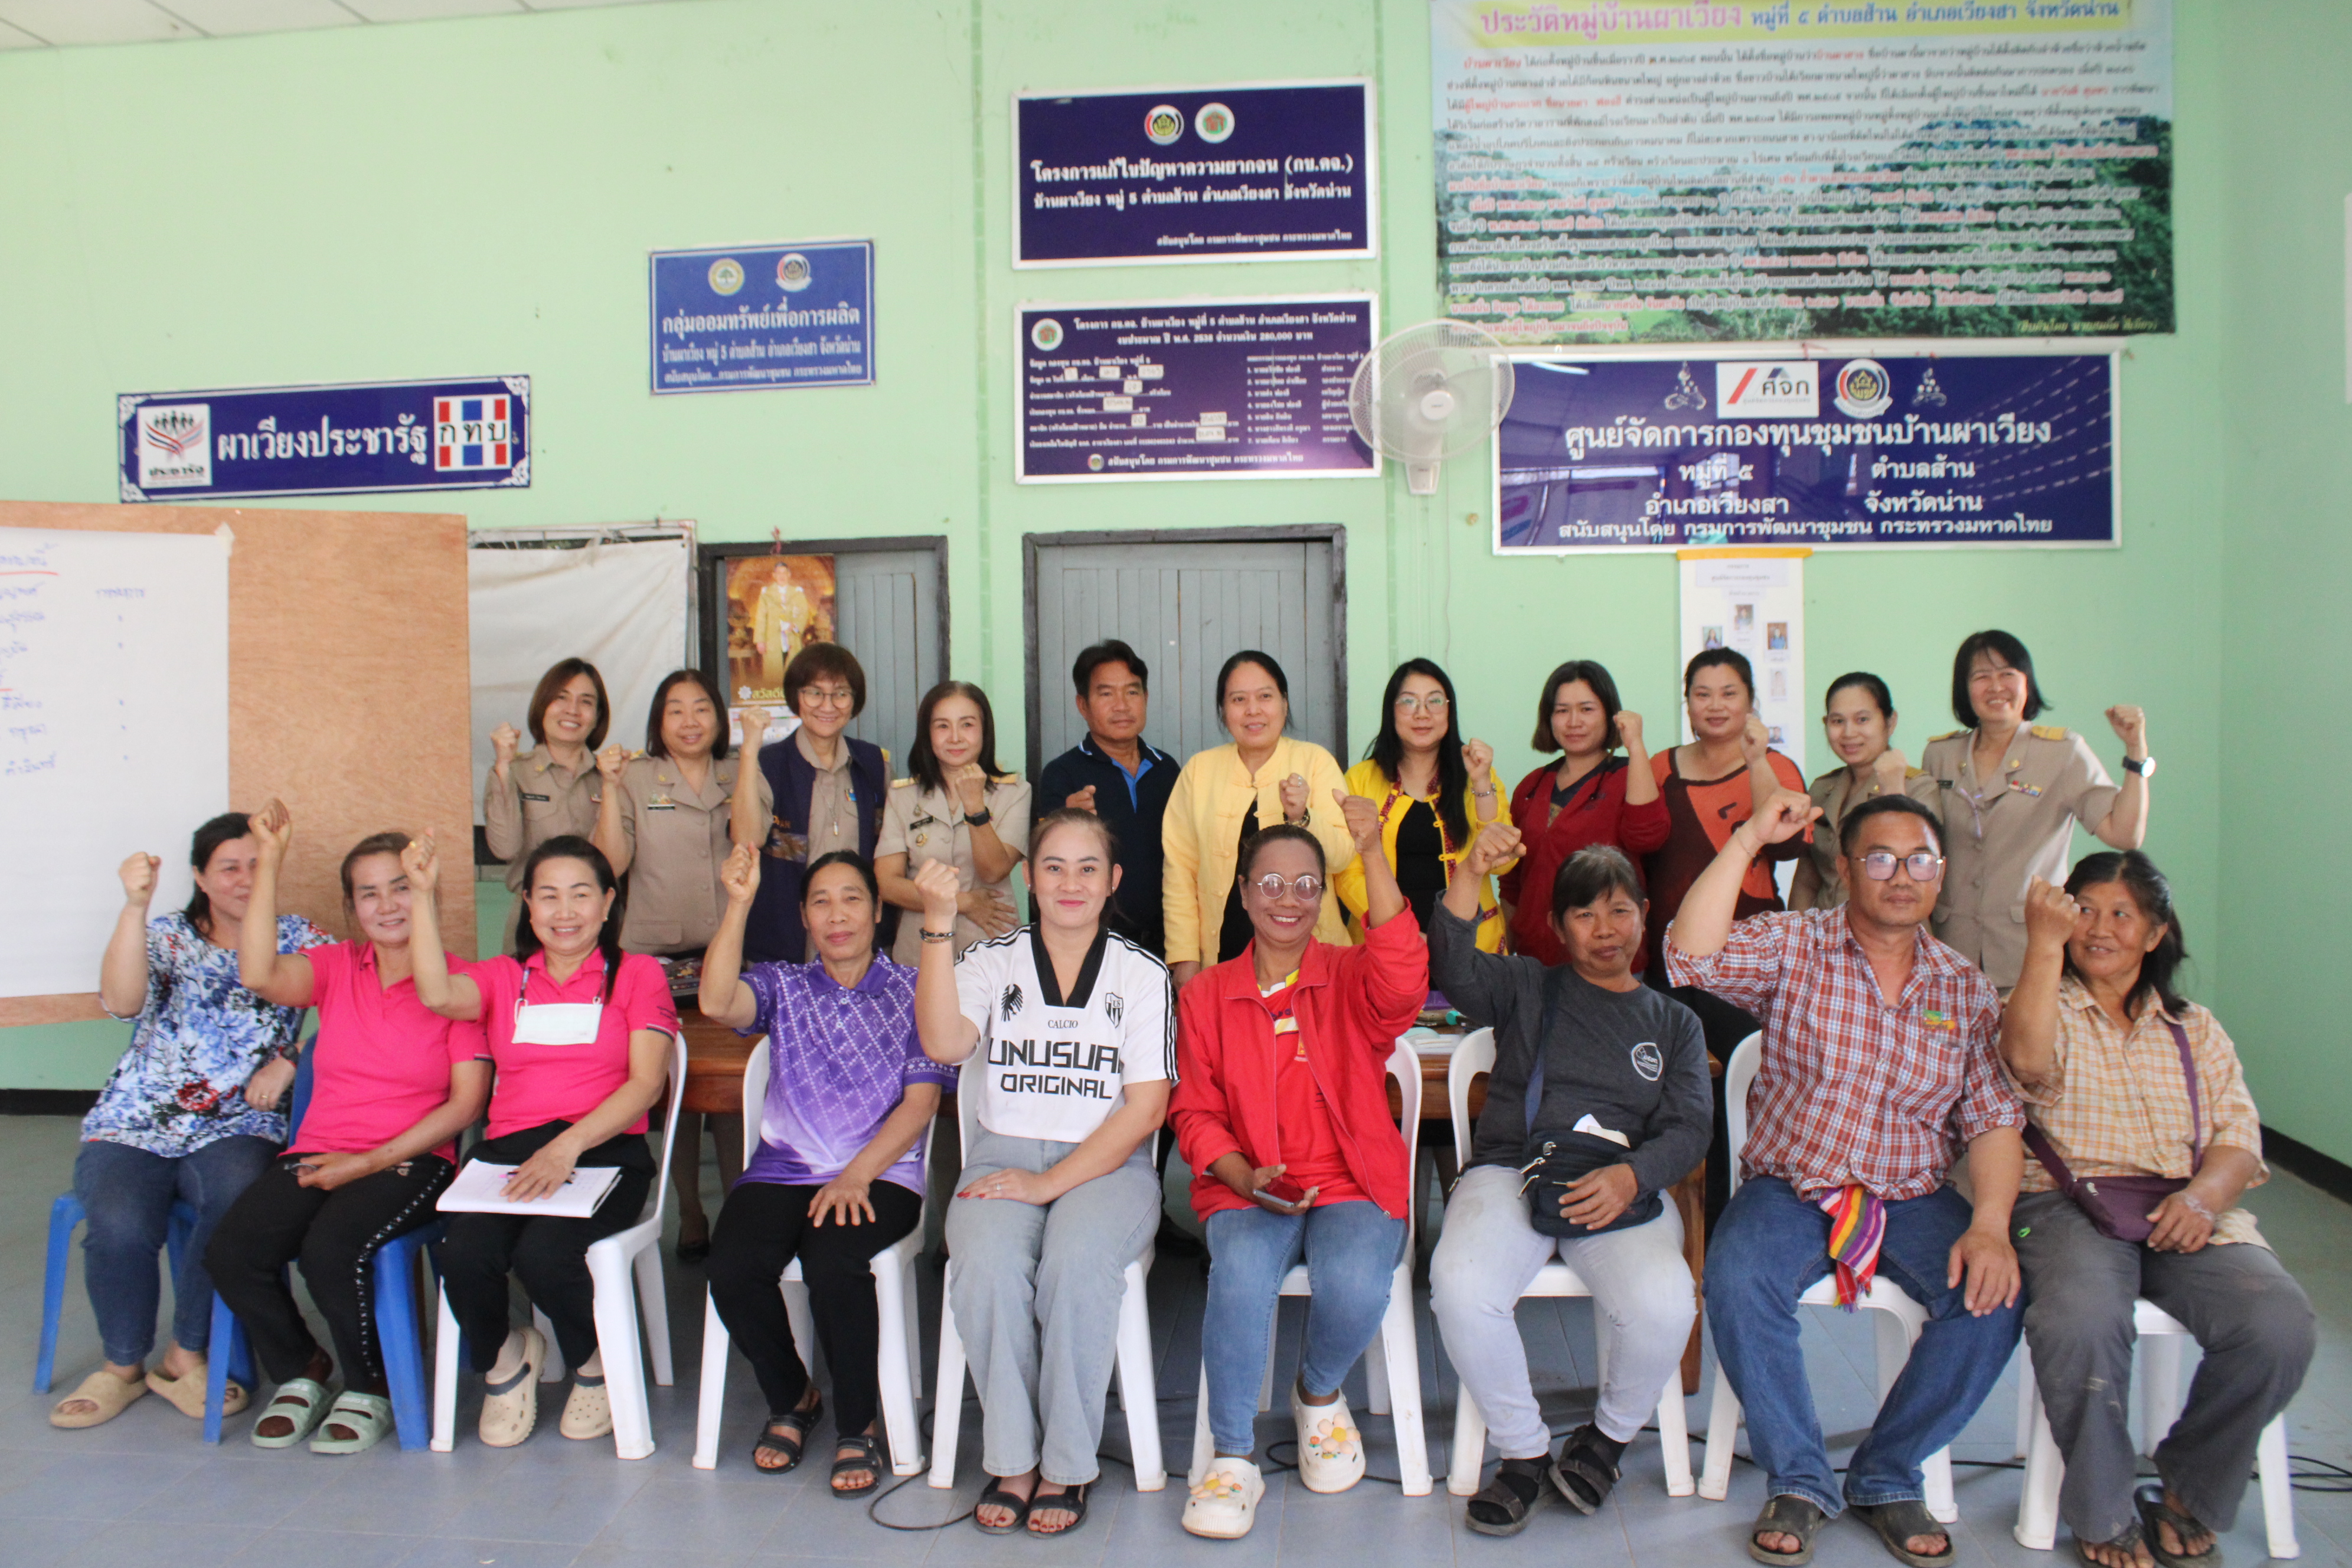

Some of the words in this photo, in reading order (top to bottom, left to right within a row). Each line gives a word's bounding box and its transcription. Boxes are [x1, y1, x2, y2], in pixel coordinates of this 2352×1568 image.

[1481, 0, 1742, 40] ประวัติหมู่บ้านผาเวียง
[1034, 190, 1101, 209] บ้านผาเวียง
[1129, 192, 1137, 205] 5
[662, 296, 860, 341] กลุ่มออมทรัพย์เพื่อการผลิต
[218, 414, 428, 466] ผาเวียงประชารัฐ
[1566, 413, 2052, 460] ศูนย์จัดการกองทุนชุมชนบ้านผาเวียง
[1679, 455, 1728, 490] หมู่ที่
[1737, 462, 1754, 482] ๕
[1871, 454, 1976, 480] ตำบลส้าน
[1645, 492, 1789, 517] อำเภอเวียงสา
[1864, 490, 1984, 514] จังหวัดน่าน
[1559, 518, 1676, 544] สนับสนุนโดย
[1684, 517, 1873, 541] กรมการพัฒนาชุมชน
[1880, 512, 2053, 534] กระทรวงมหาดไทย
[1048, 1020, 1079, 1029] CALCIO
[988, 1037, 1121, 1074] UNUSUA
[1000, 1073, 1113, 1100] ORIGINAL
